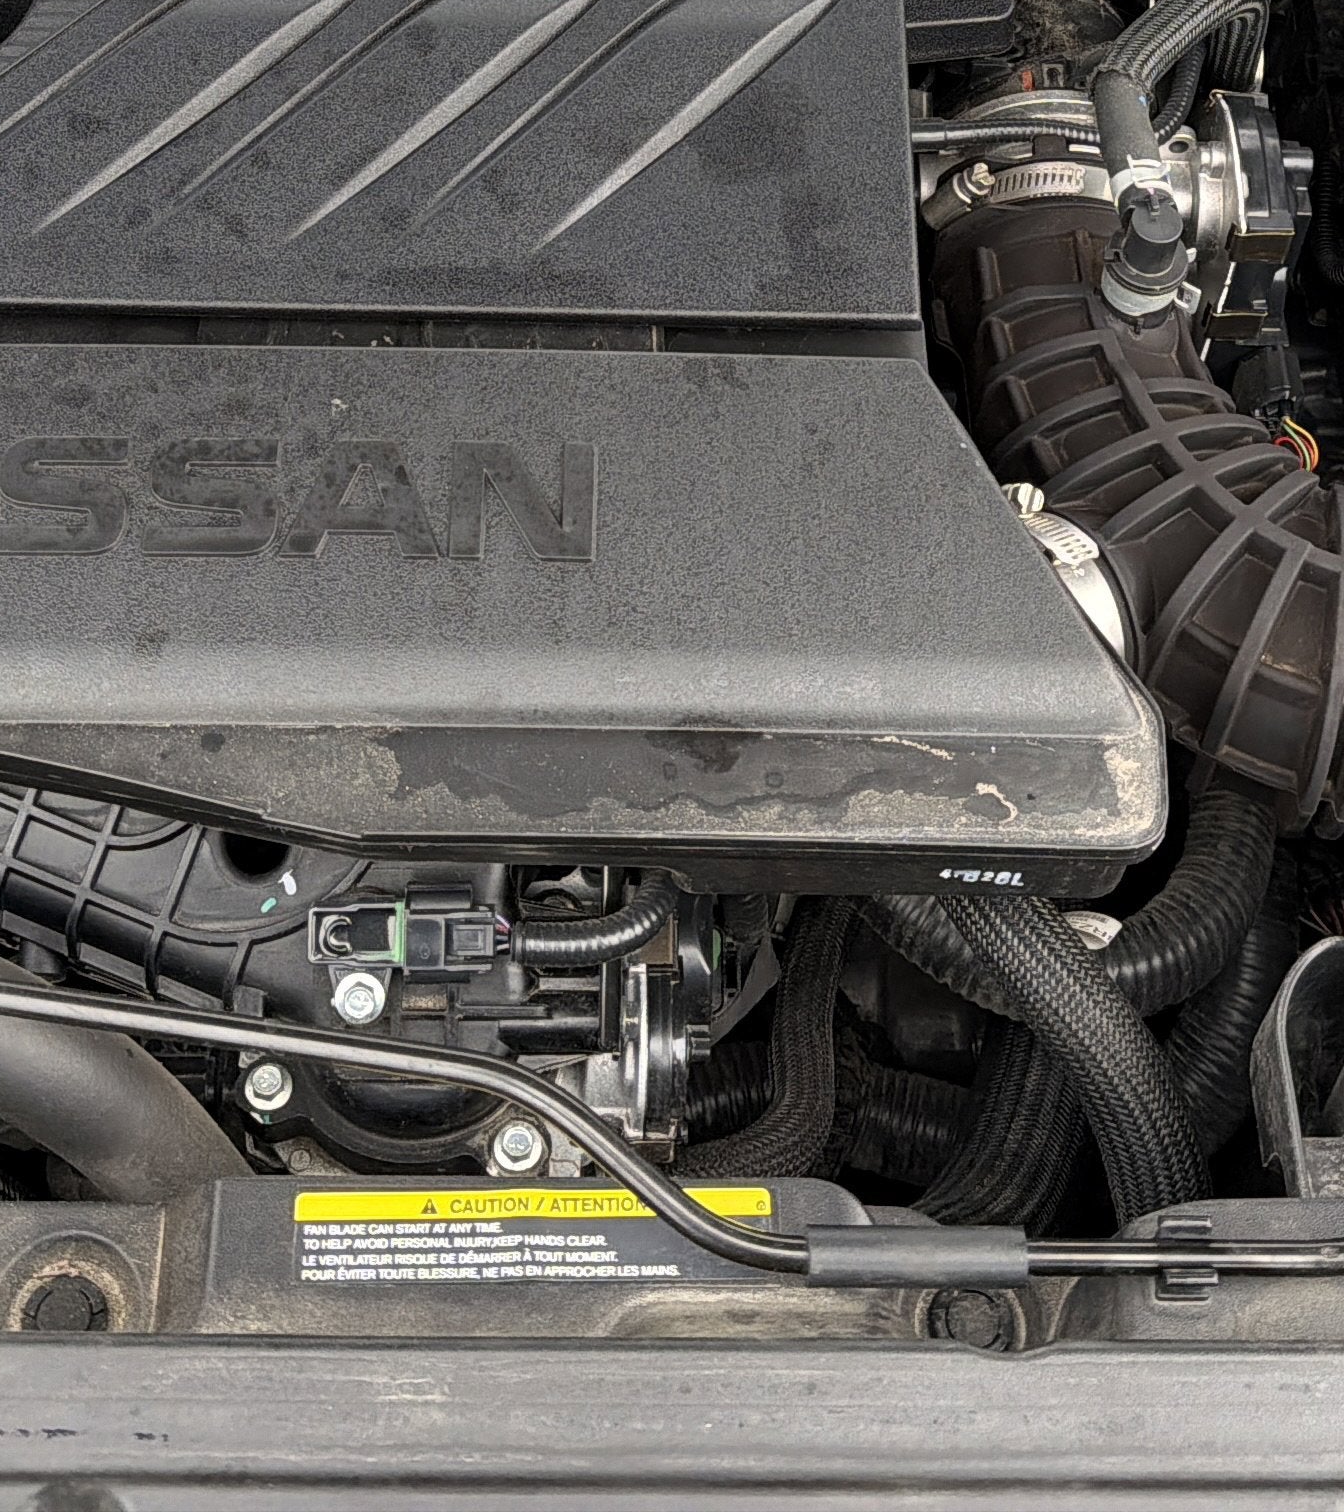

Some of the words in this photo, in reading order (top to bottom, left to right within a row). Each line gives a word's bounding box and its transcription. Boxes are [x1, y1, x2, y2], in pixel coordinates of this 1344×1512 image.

[450, 1198, 529, 1213] CAUTION
[535, 1197, 545, 1211] /
[304, 1224, 327, 1235] FAN
[329, 1224, 366, 1235] BLADE
[368, 1224, 394, 1235] CAN
[395, 1224, 431, 1234] START
[433, 1223, 447, 1234] AT
[449, 1223, 473, 1233] ANY
[475, 1222, 503, 1233] TIME.
[304, 1239, 320, 1250] TO
[322, 1239, 353, 1249] HELP
[353, 1238, 388, 1249] AVOID
[391, 1238, 452, 1248] PERSONAL
[525, 1235, 565, 1246] HANDS
[567, 1235, 608, 1246] CLEAR.
[302, 1255, 318, 1266] LE
[319, 1254, 393, 1266] VENTILATEUR
[395, 1253, 438, 1265] RISQUE
[440, 1253, 455, 1264] DE
[458, 1250, 521, 1264] DÉMARRER
[524, 1248, 533, 1261] À
[534, 1251, 564, 1262] TOUT
[566, 1251, 618, 1262] MOMENT.
[302, 1269, 336, 1280] POUR
[337, 1266, 377, 1280] ÉVITER
[379, 1269, 416, 1279] TOUTE
[418, 1267, 480, 1279] BLESSURE,
[483, 1267, 498, 1278] NE
[501, 1266, 524, 1277] PAS
[526, 1266, 542, 1276] EN
[544, 1266, 617, 1277] APPROCHER
[618, 1266, 640, 1276] LES
[641, 1266, 680, 1276] MAINS.
